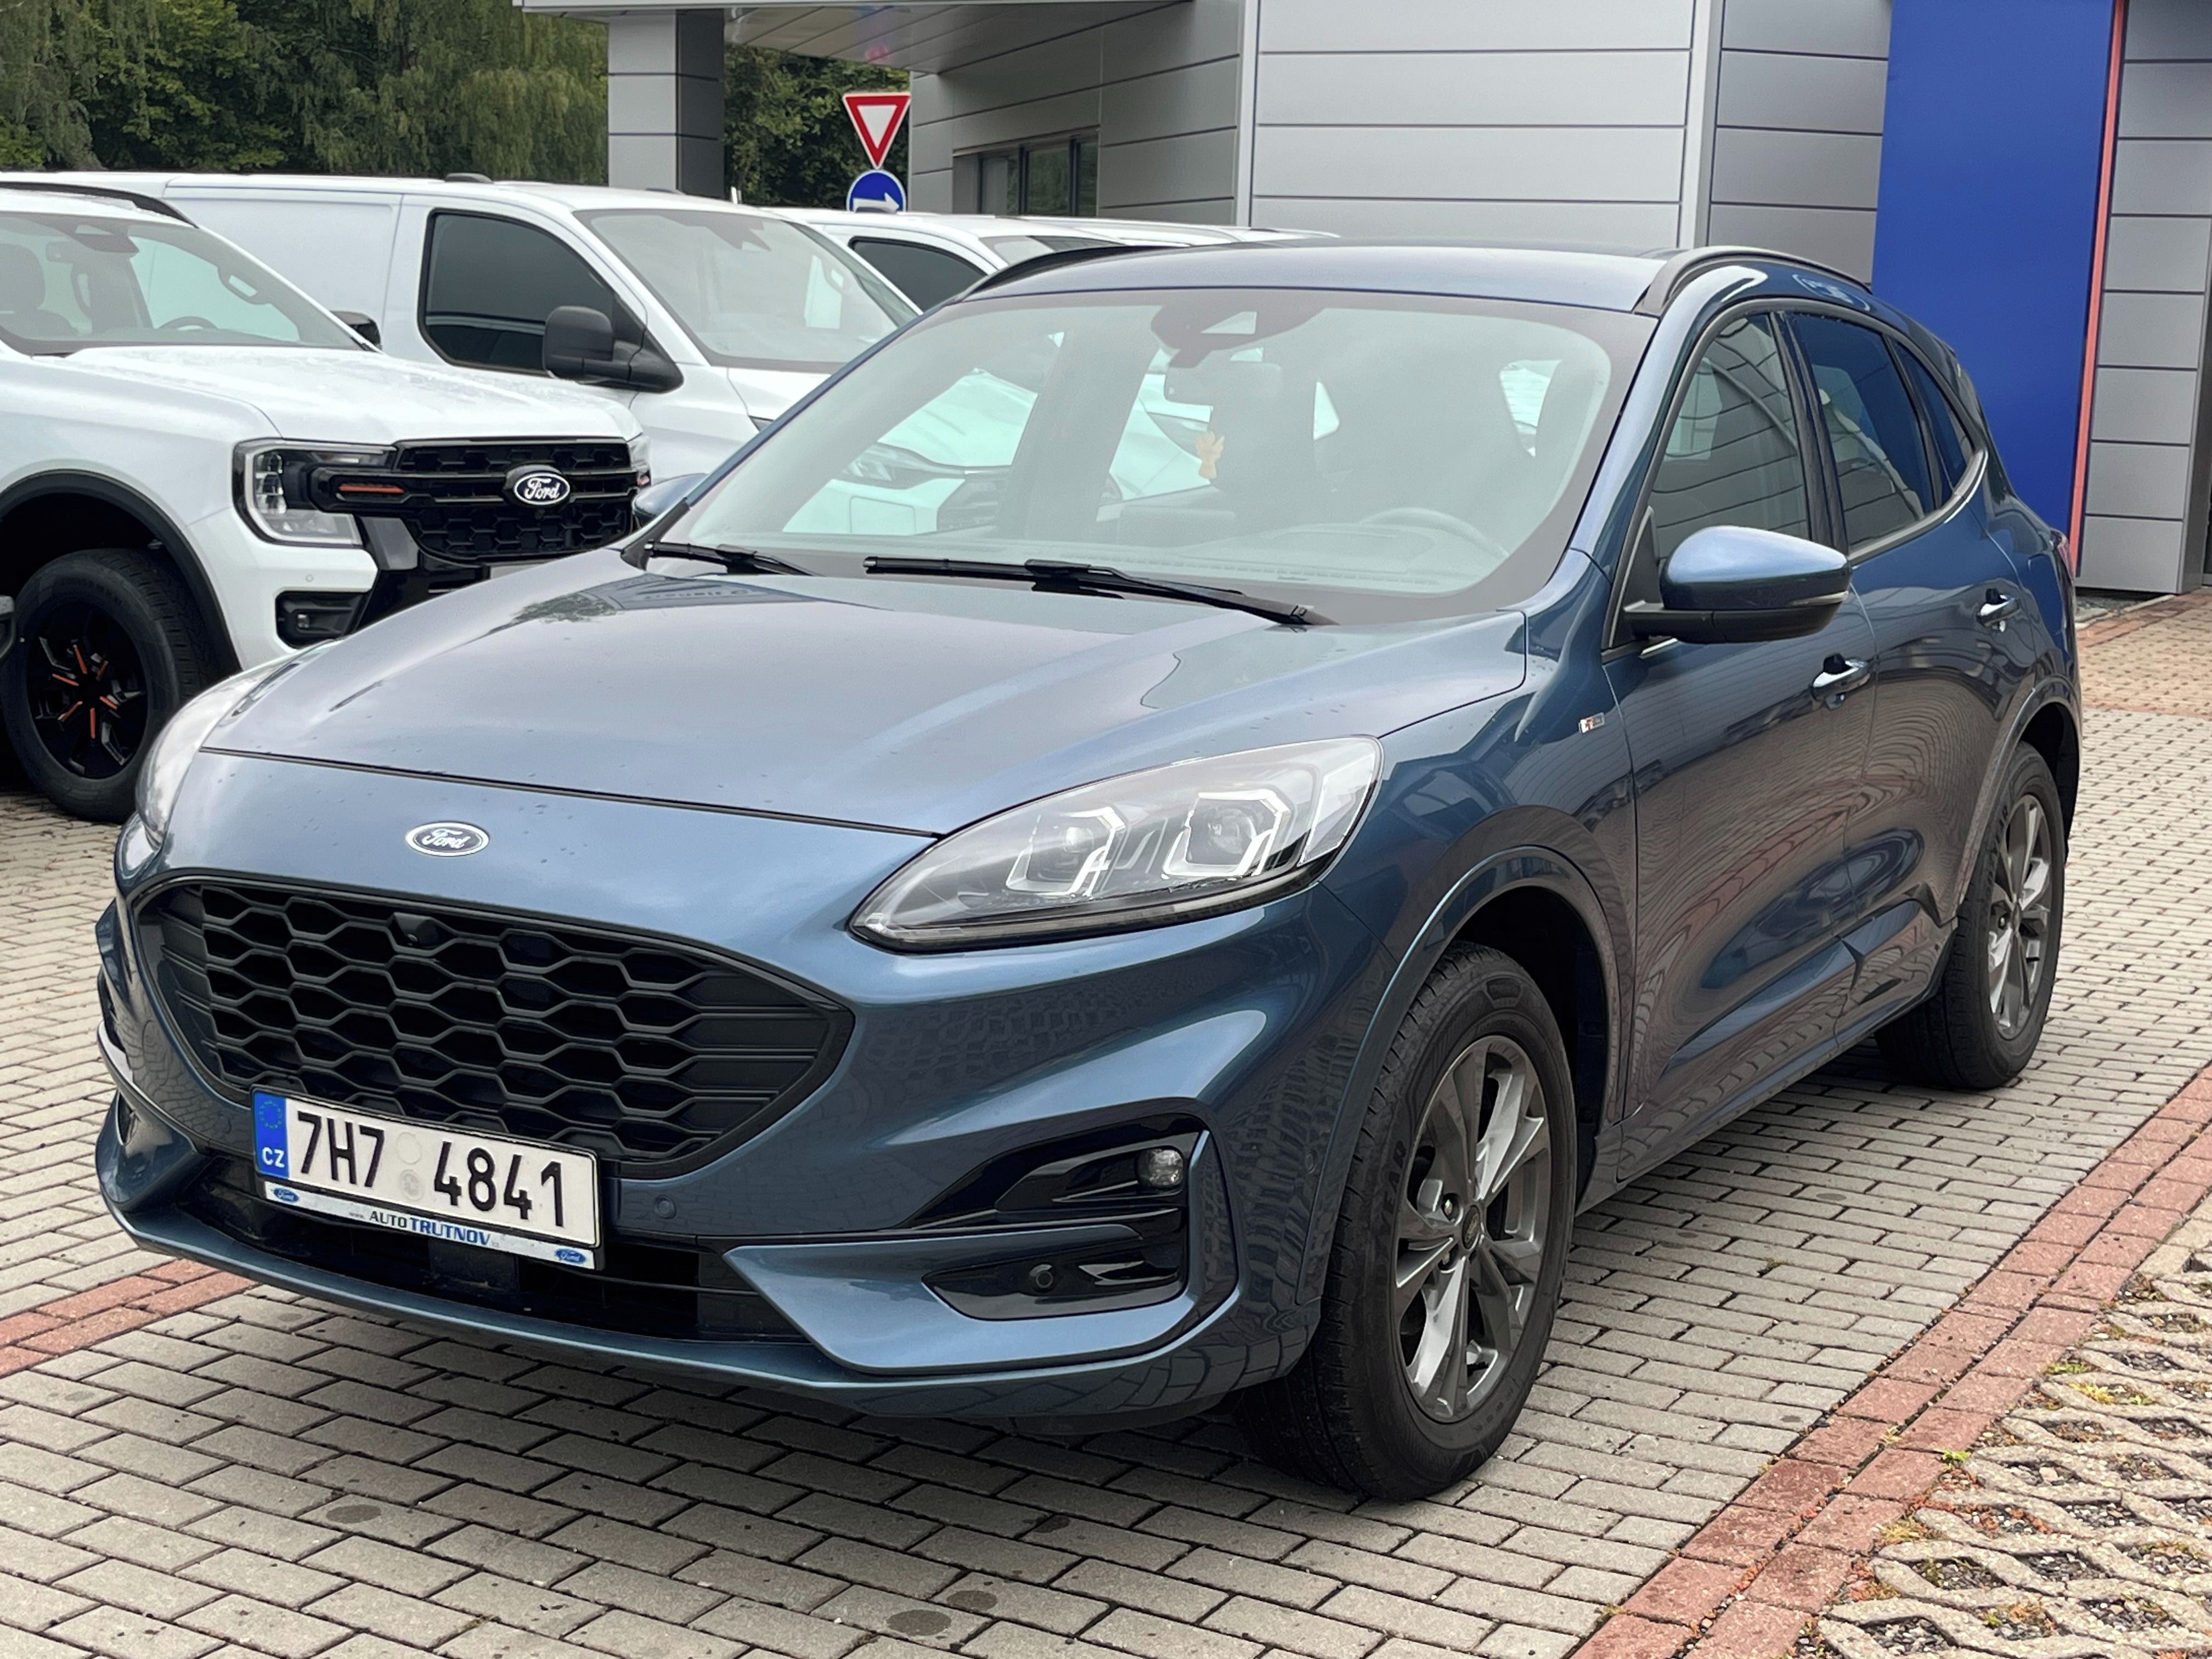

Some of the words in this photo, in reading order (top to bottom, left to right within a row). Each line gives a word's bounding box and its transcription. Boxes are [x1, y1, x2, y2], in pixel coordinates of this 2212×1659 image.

[524, 477, 561, 500] Ford
[421, 828, 471, 849] Ford
[262, 1147, 285, 1168] CZ
[297, 1110, 385, 1188] 7H7
[434, 1141, 563, 1227] 4841
